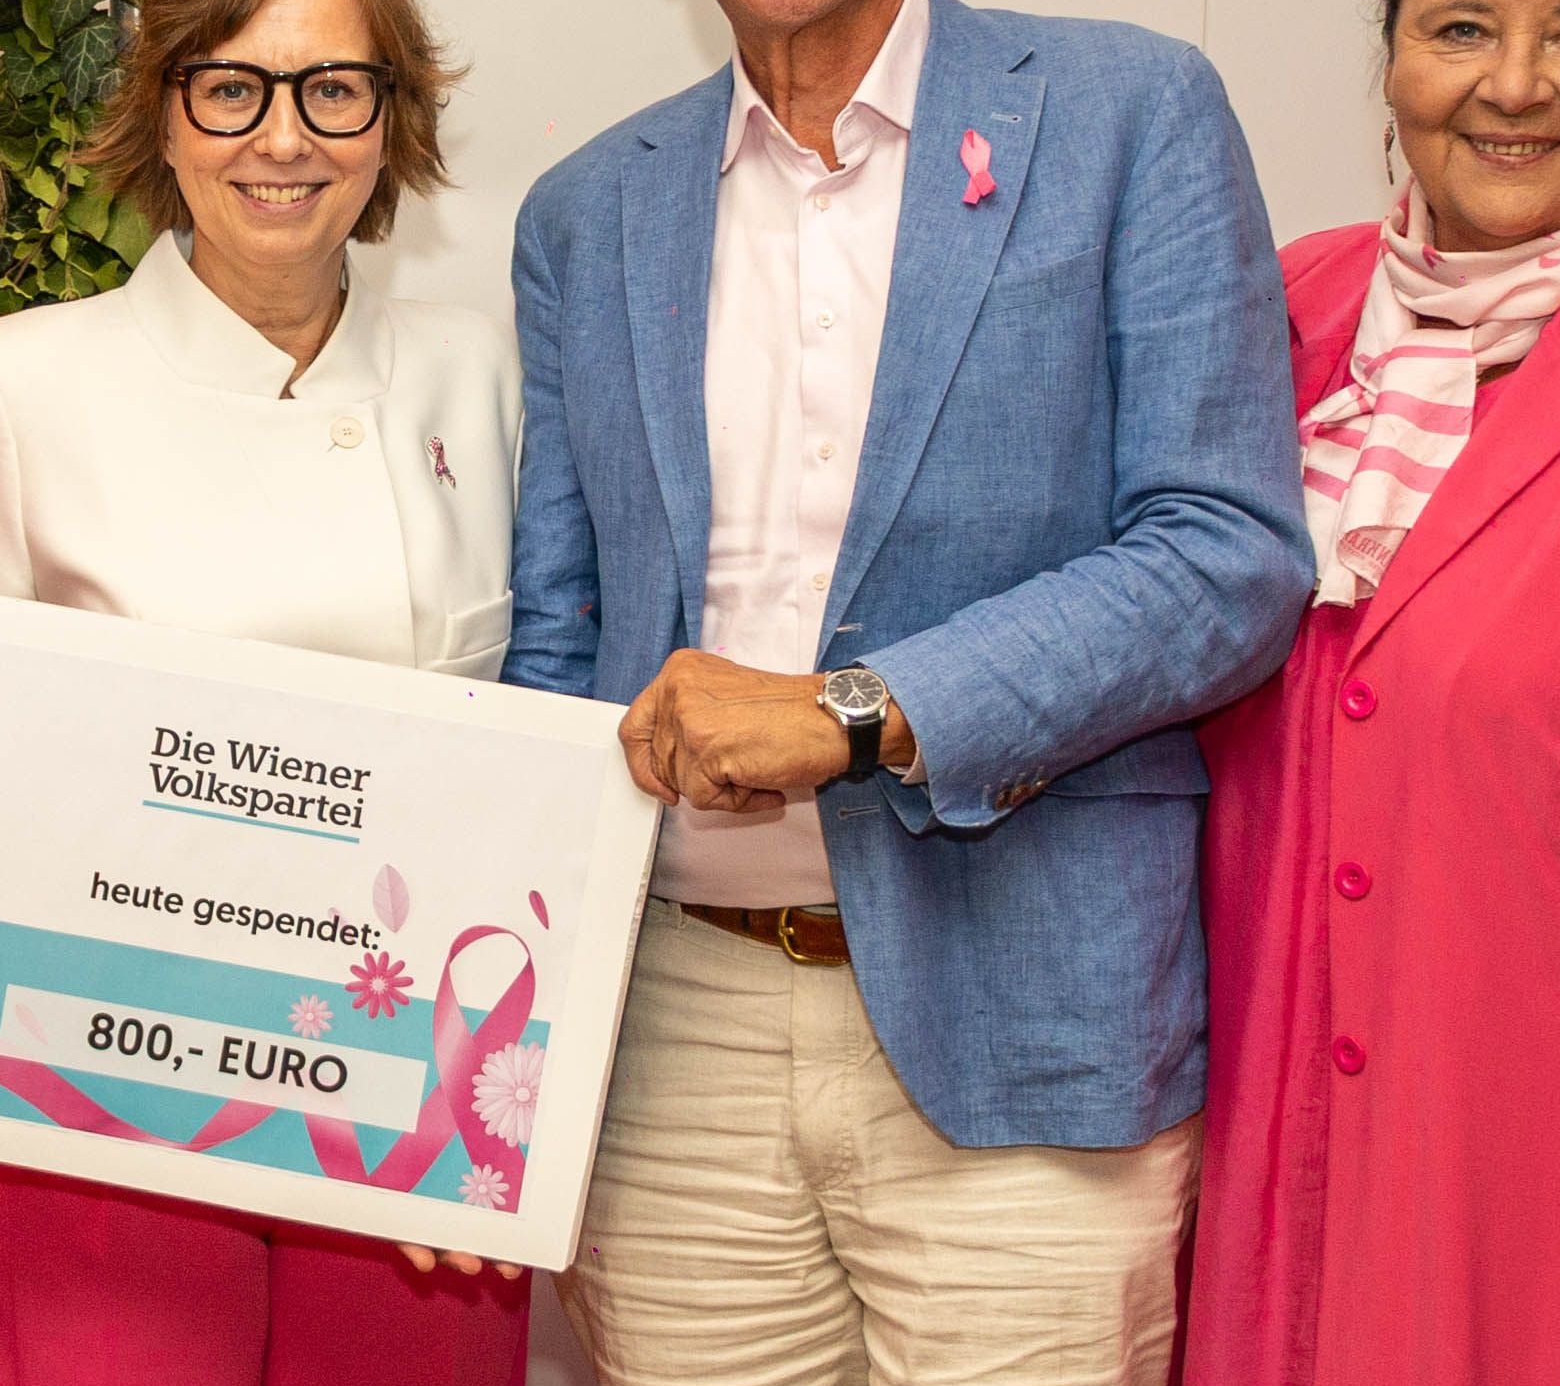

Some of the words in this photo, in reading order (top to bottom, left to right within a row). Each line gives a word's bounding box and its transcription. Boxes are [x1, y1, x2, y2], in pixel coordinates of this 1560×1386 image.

[148, 762, 364, 829] Volkspartei
[150, 726, 217, 765] Die
[227, 739, 371, 793] Wiener
[91, 873, 183, 914] heute
[194, 899, 380, 950] gespendet:
[88, 1013, 203, 1071] 800,-
[219, 1037, 348, 1093] EURO
